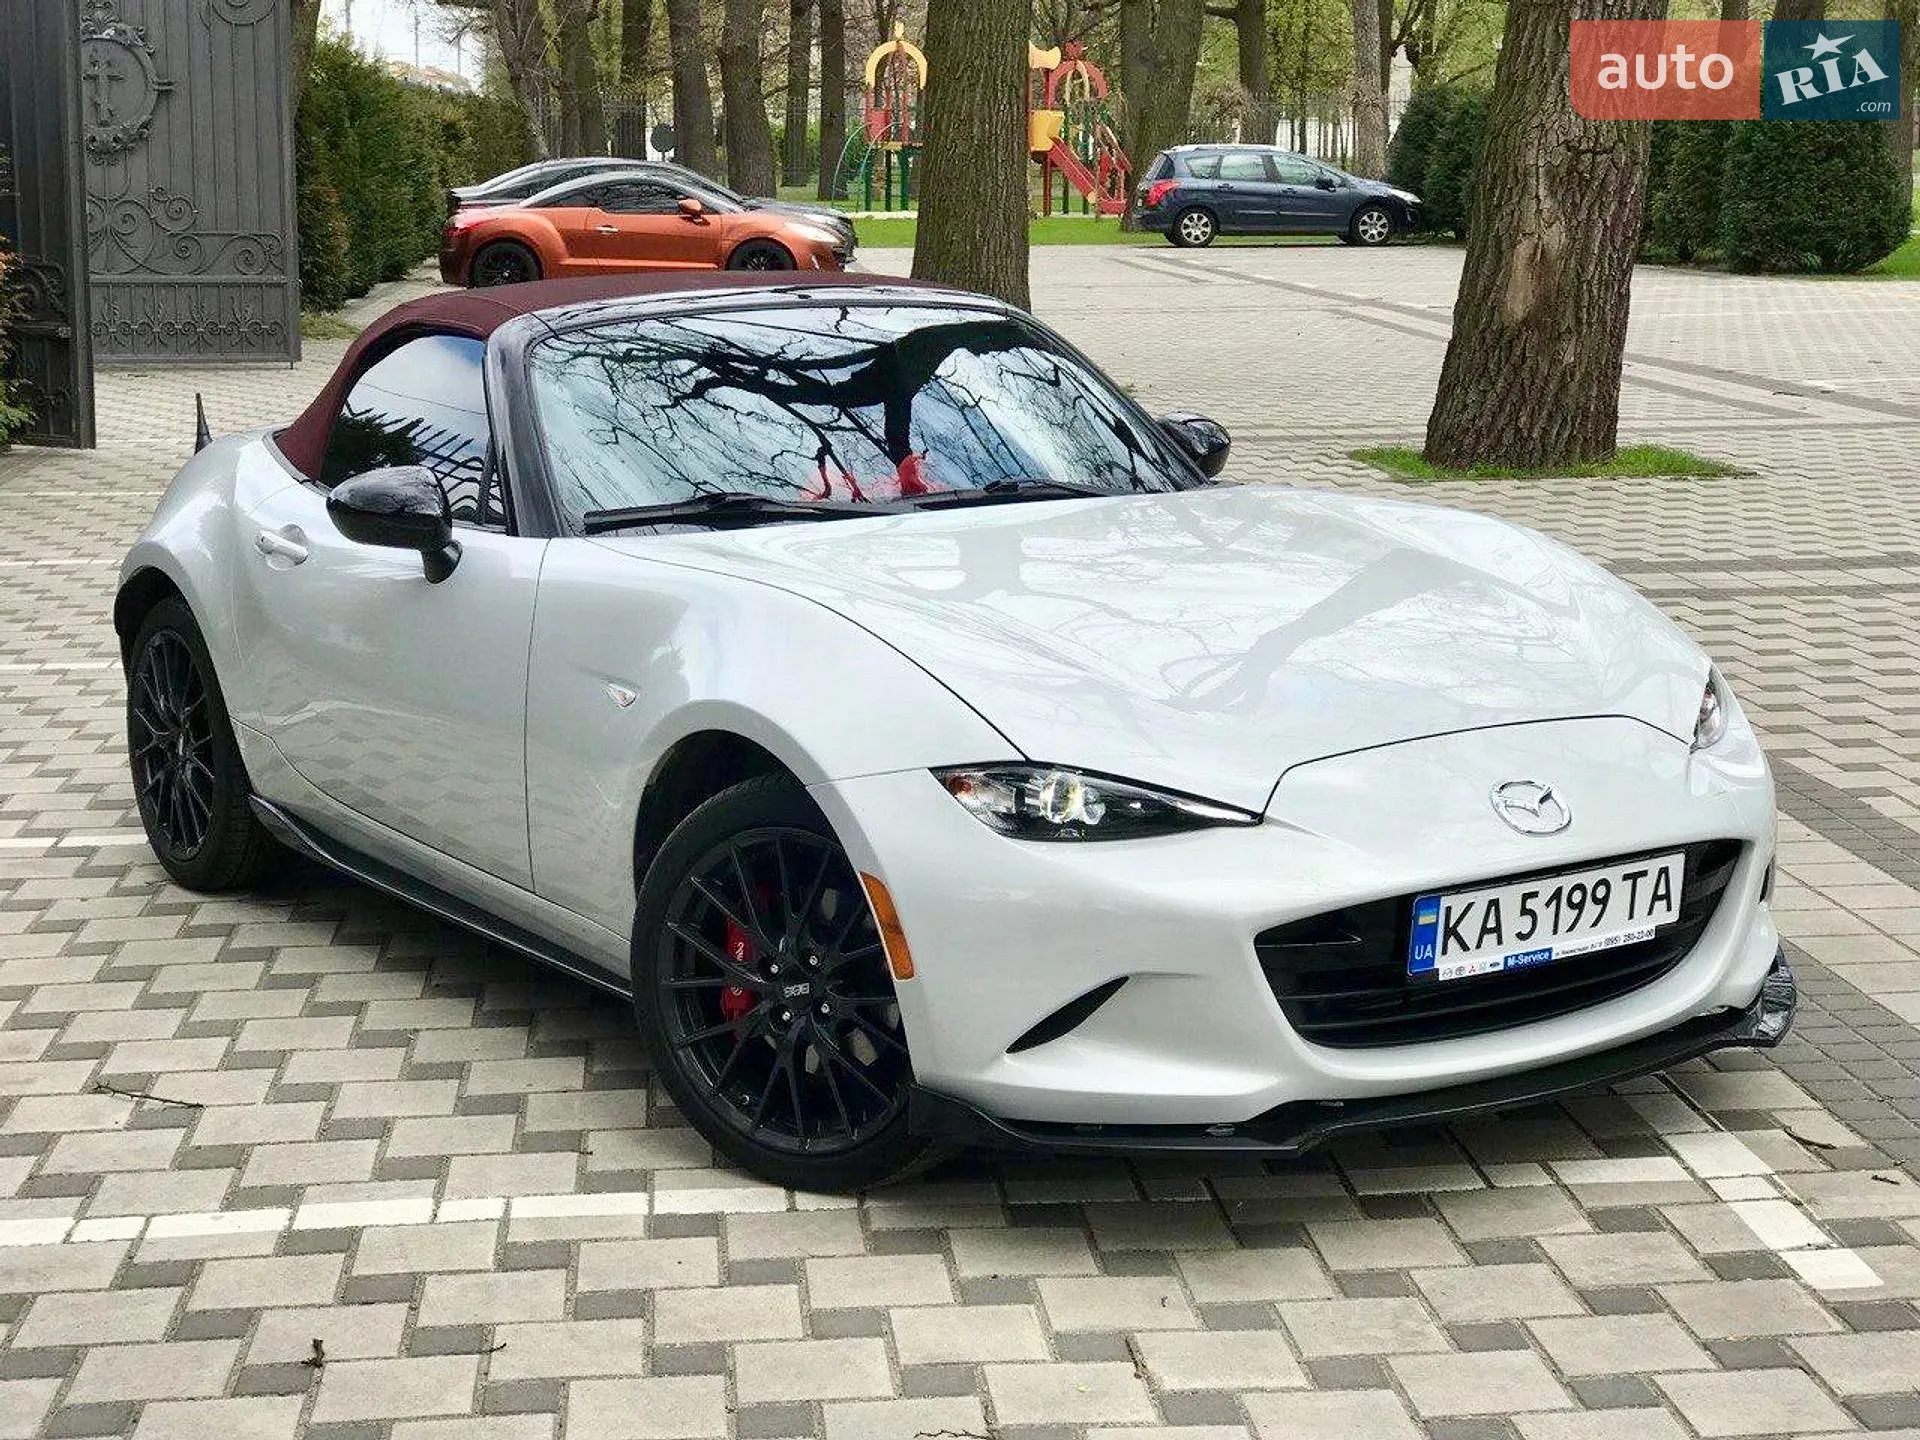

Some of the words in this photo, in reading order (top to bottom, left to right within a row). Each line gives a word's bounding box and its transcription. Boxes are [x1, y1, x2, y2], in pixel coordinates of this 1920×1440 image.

[1441, 897, 1504, 956] KA
[1514, 877, 1612, 942] 5199
[1621, 865, 1673, 921] TA
[1414, 943, 1434, 960] UA
[1507, 949, 1550, 967] M-Service
